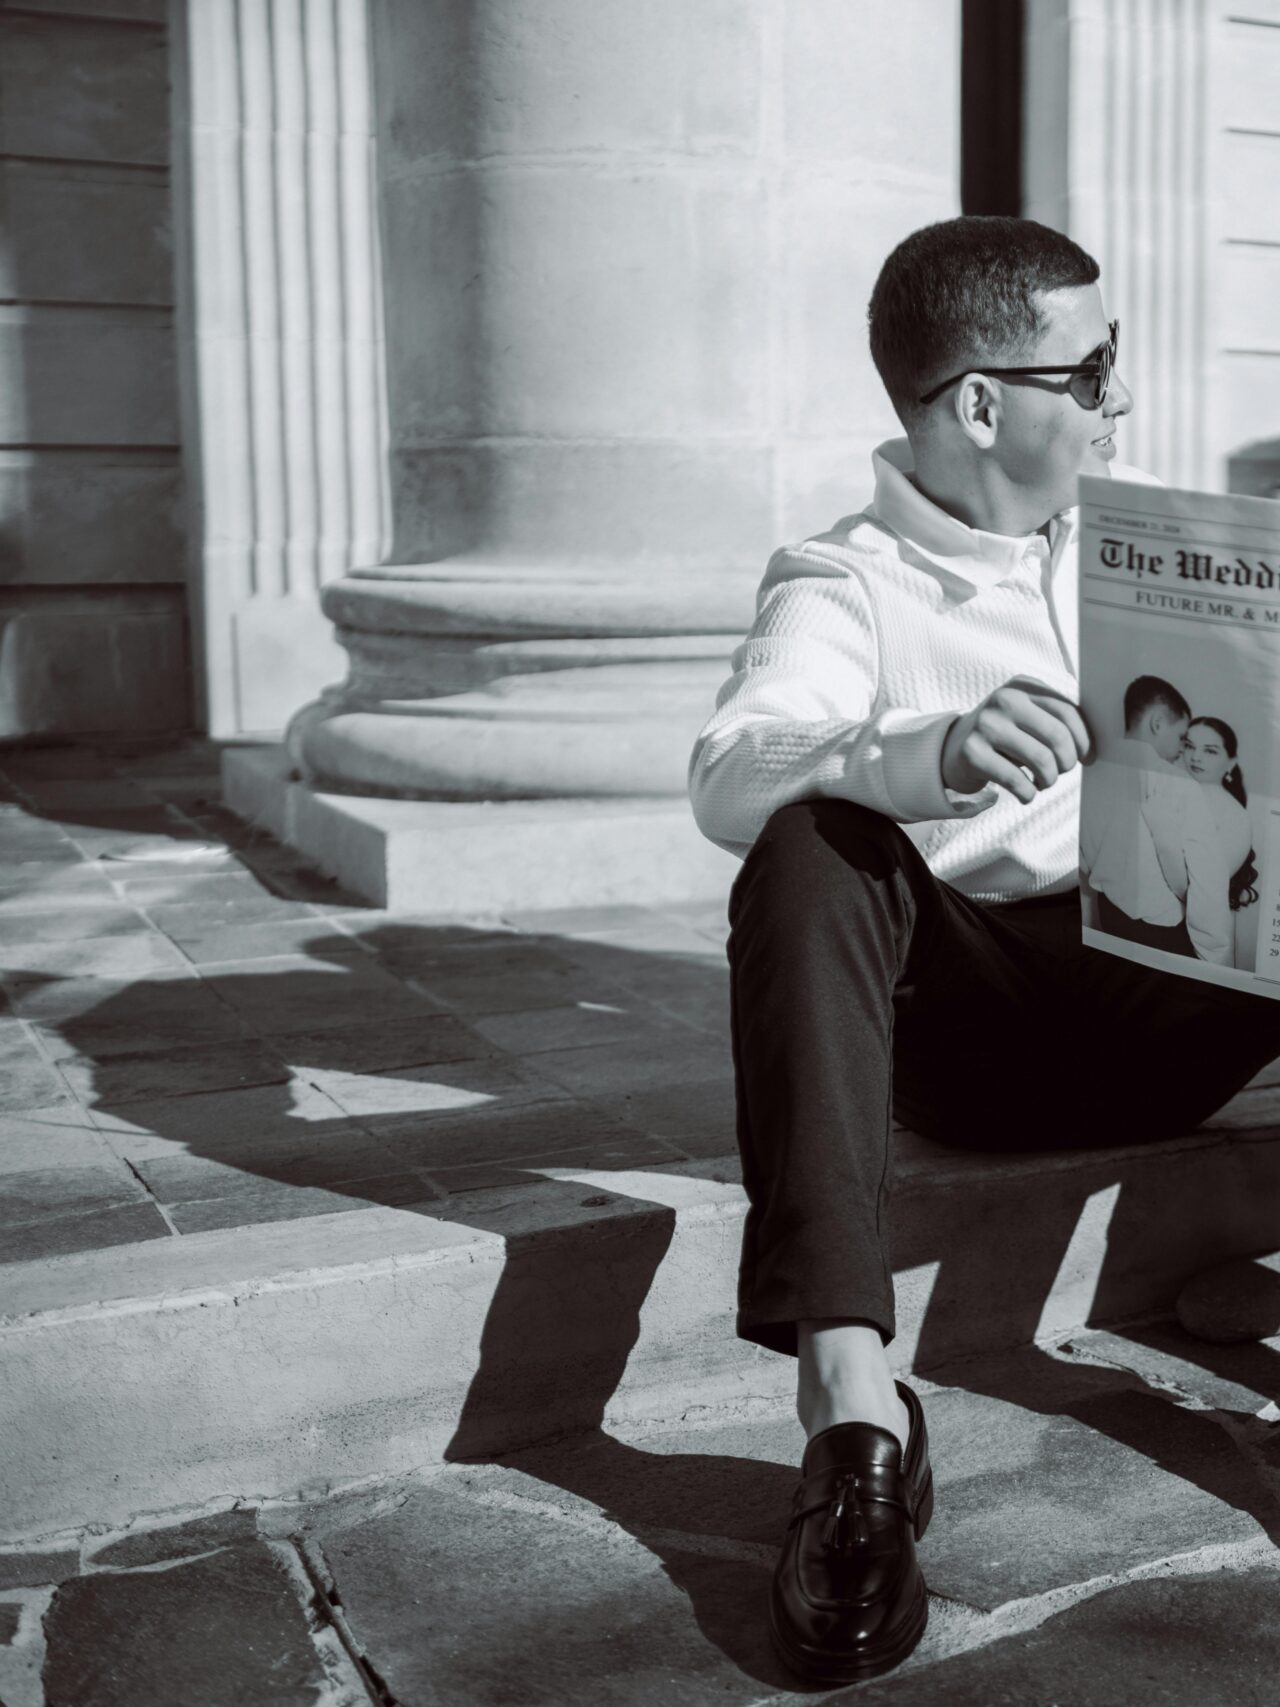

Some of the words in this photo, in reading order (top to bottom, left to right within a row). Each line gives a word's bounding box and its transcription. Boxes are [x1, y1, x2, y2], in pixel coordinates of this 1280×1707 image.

[1100, 538, 1164, 579] The
[1136, 591, 1204, 613] FUTURE
[1207, 602, 1239, 619] MR.
[1242, 608, 1255, 620] &
[1272, 918, 1280, 927] 15
[1272, 933, 1280, 943] 22
[1269, 948, 1279, 957] 29
